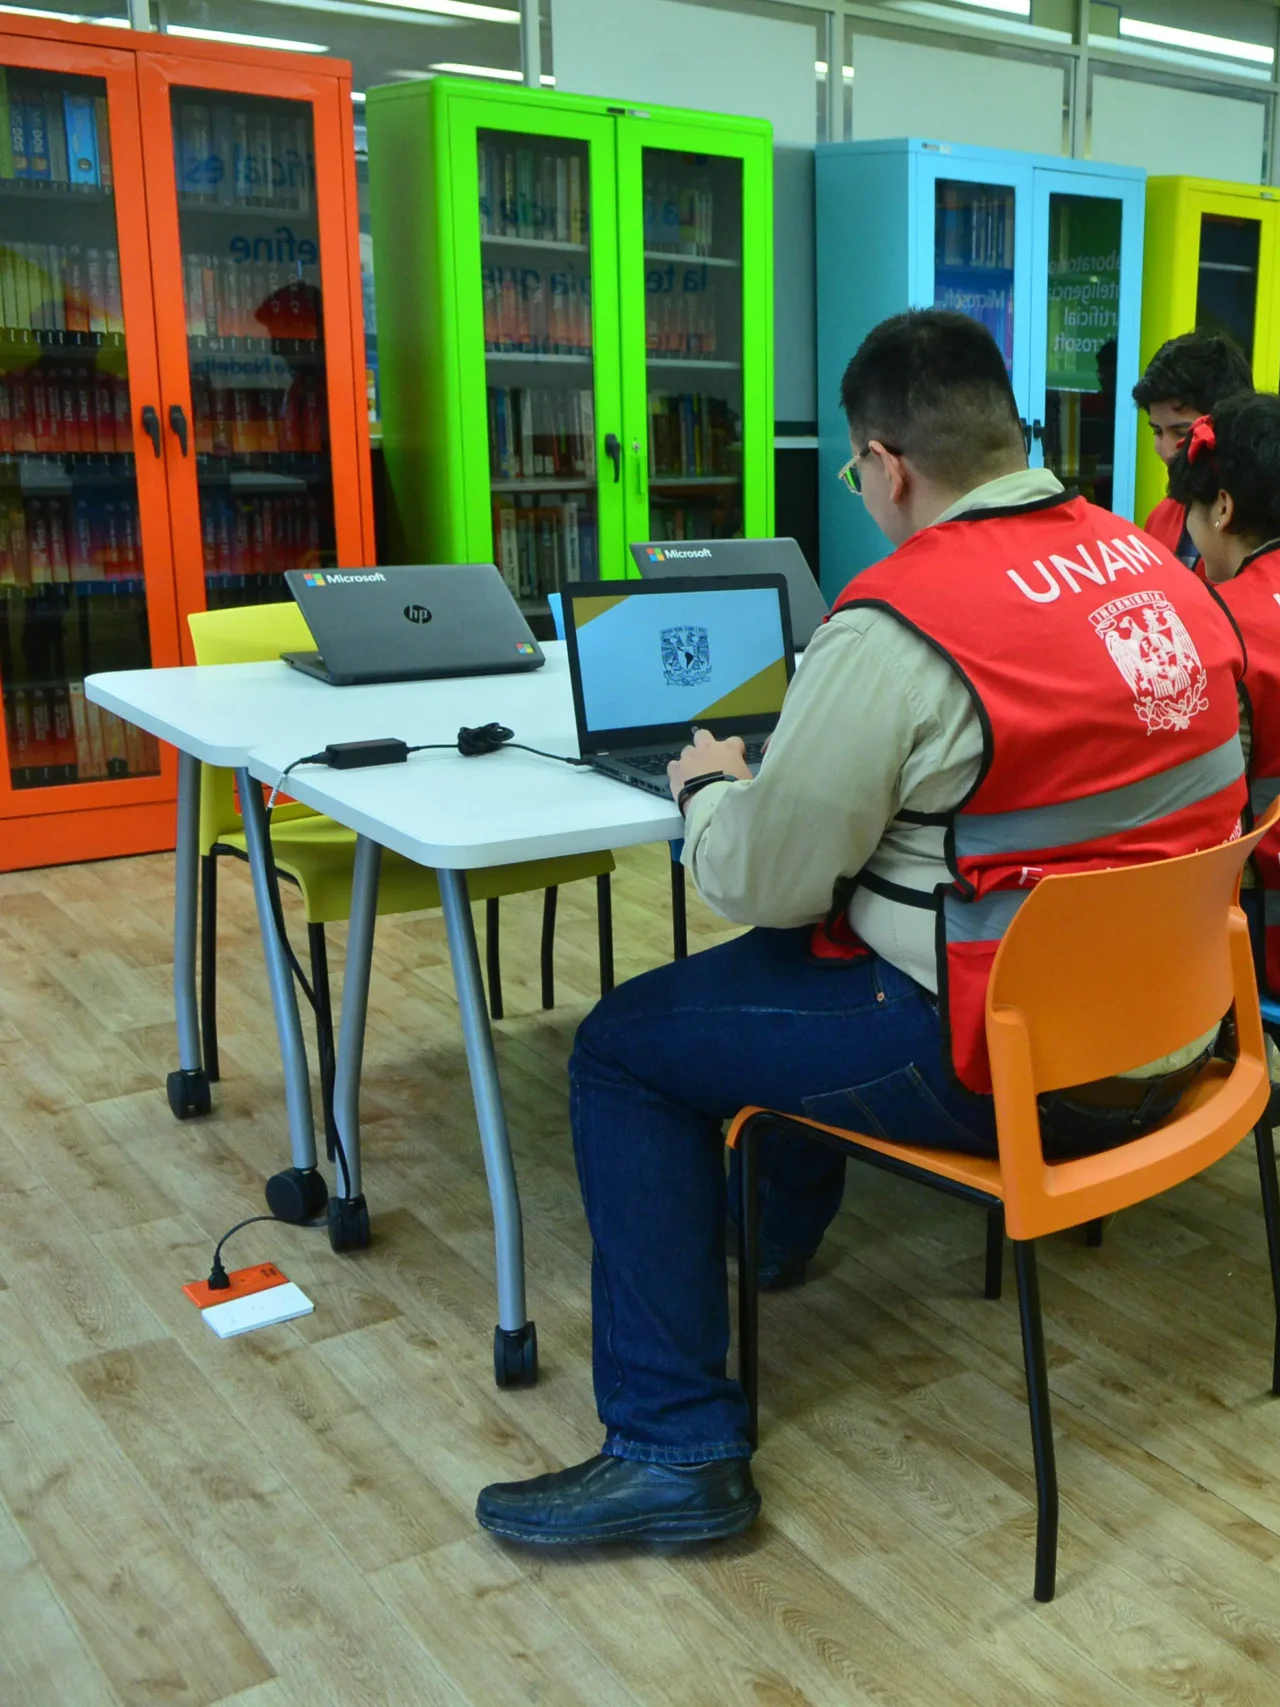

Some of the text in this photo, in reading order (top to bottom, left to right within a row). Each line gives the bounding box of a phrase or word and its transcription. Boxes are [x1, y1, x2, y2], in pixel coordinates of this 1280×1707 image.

[664, 548, 713, 560] Microsoft
[1006, 534, 1163, 603] UNAM
[326, 572, 387, 585] Microsoft
[406, 605, 430, 624] hp
[1094, 592, 1163, 622] INGENIERIA
